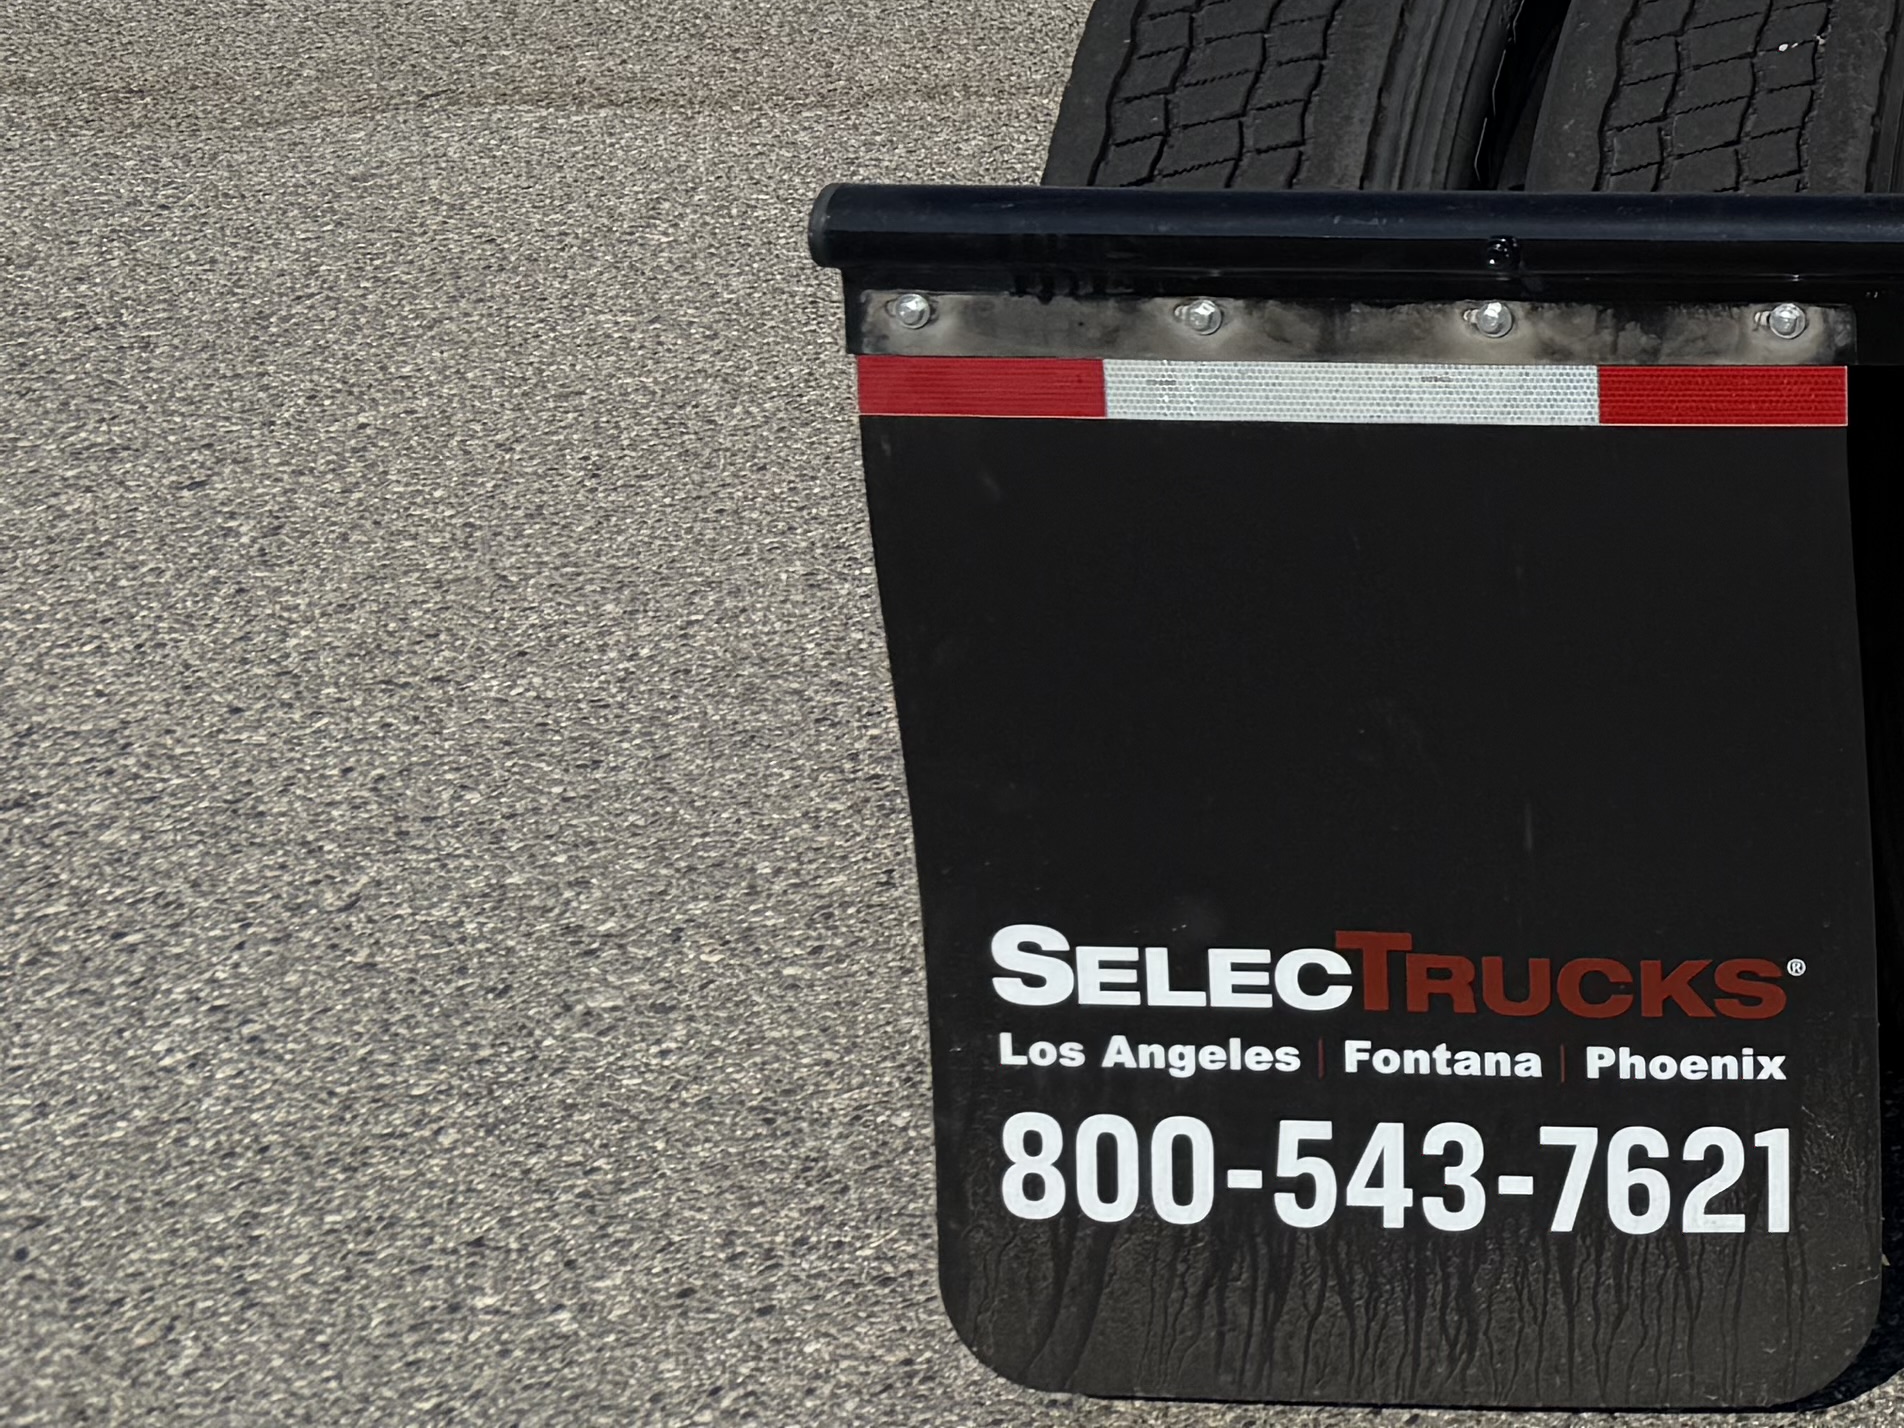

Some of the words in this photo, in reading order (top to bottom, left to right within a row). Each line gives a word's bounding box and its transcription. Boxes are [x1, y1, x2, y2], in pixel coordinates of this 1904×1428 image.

[999, 1032, 1085, 1068] Los
[1101, 1035, 1301, 1079] Angeles
[1344, 1040, 1543, 1078] Fontana
[1586, 1045, 1787, 1081] Phoenix
[1001, 1111, 1791, 1235] 800-543-7621
